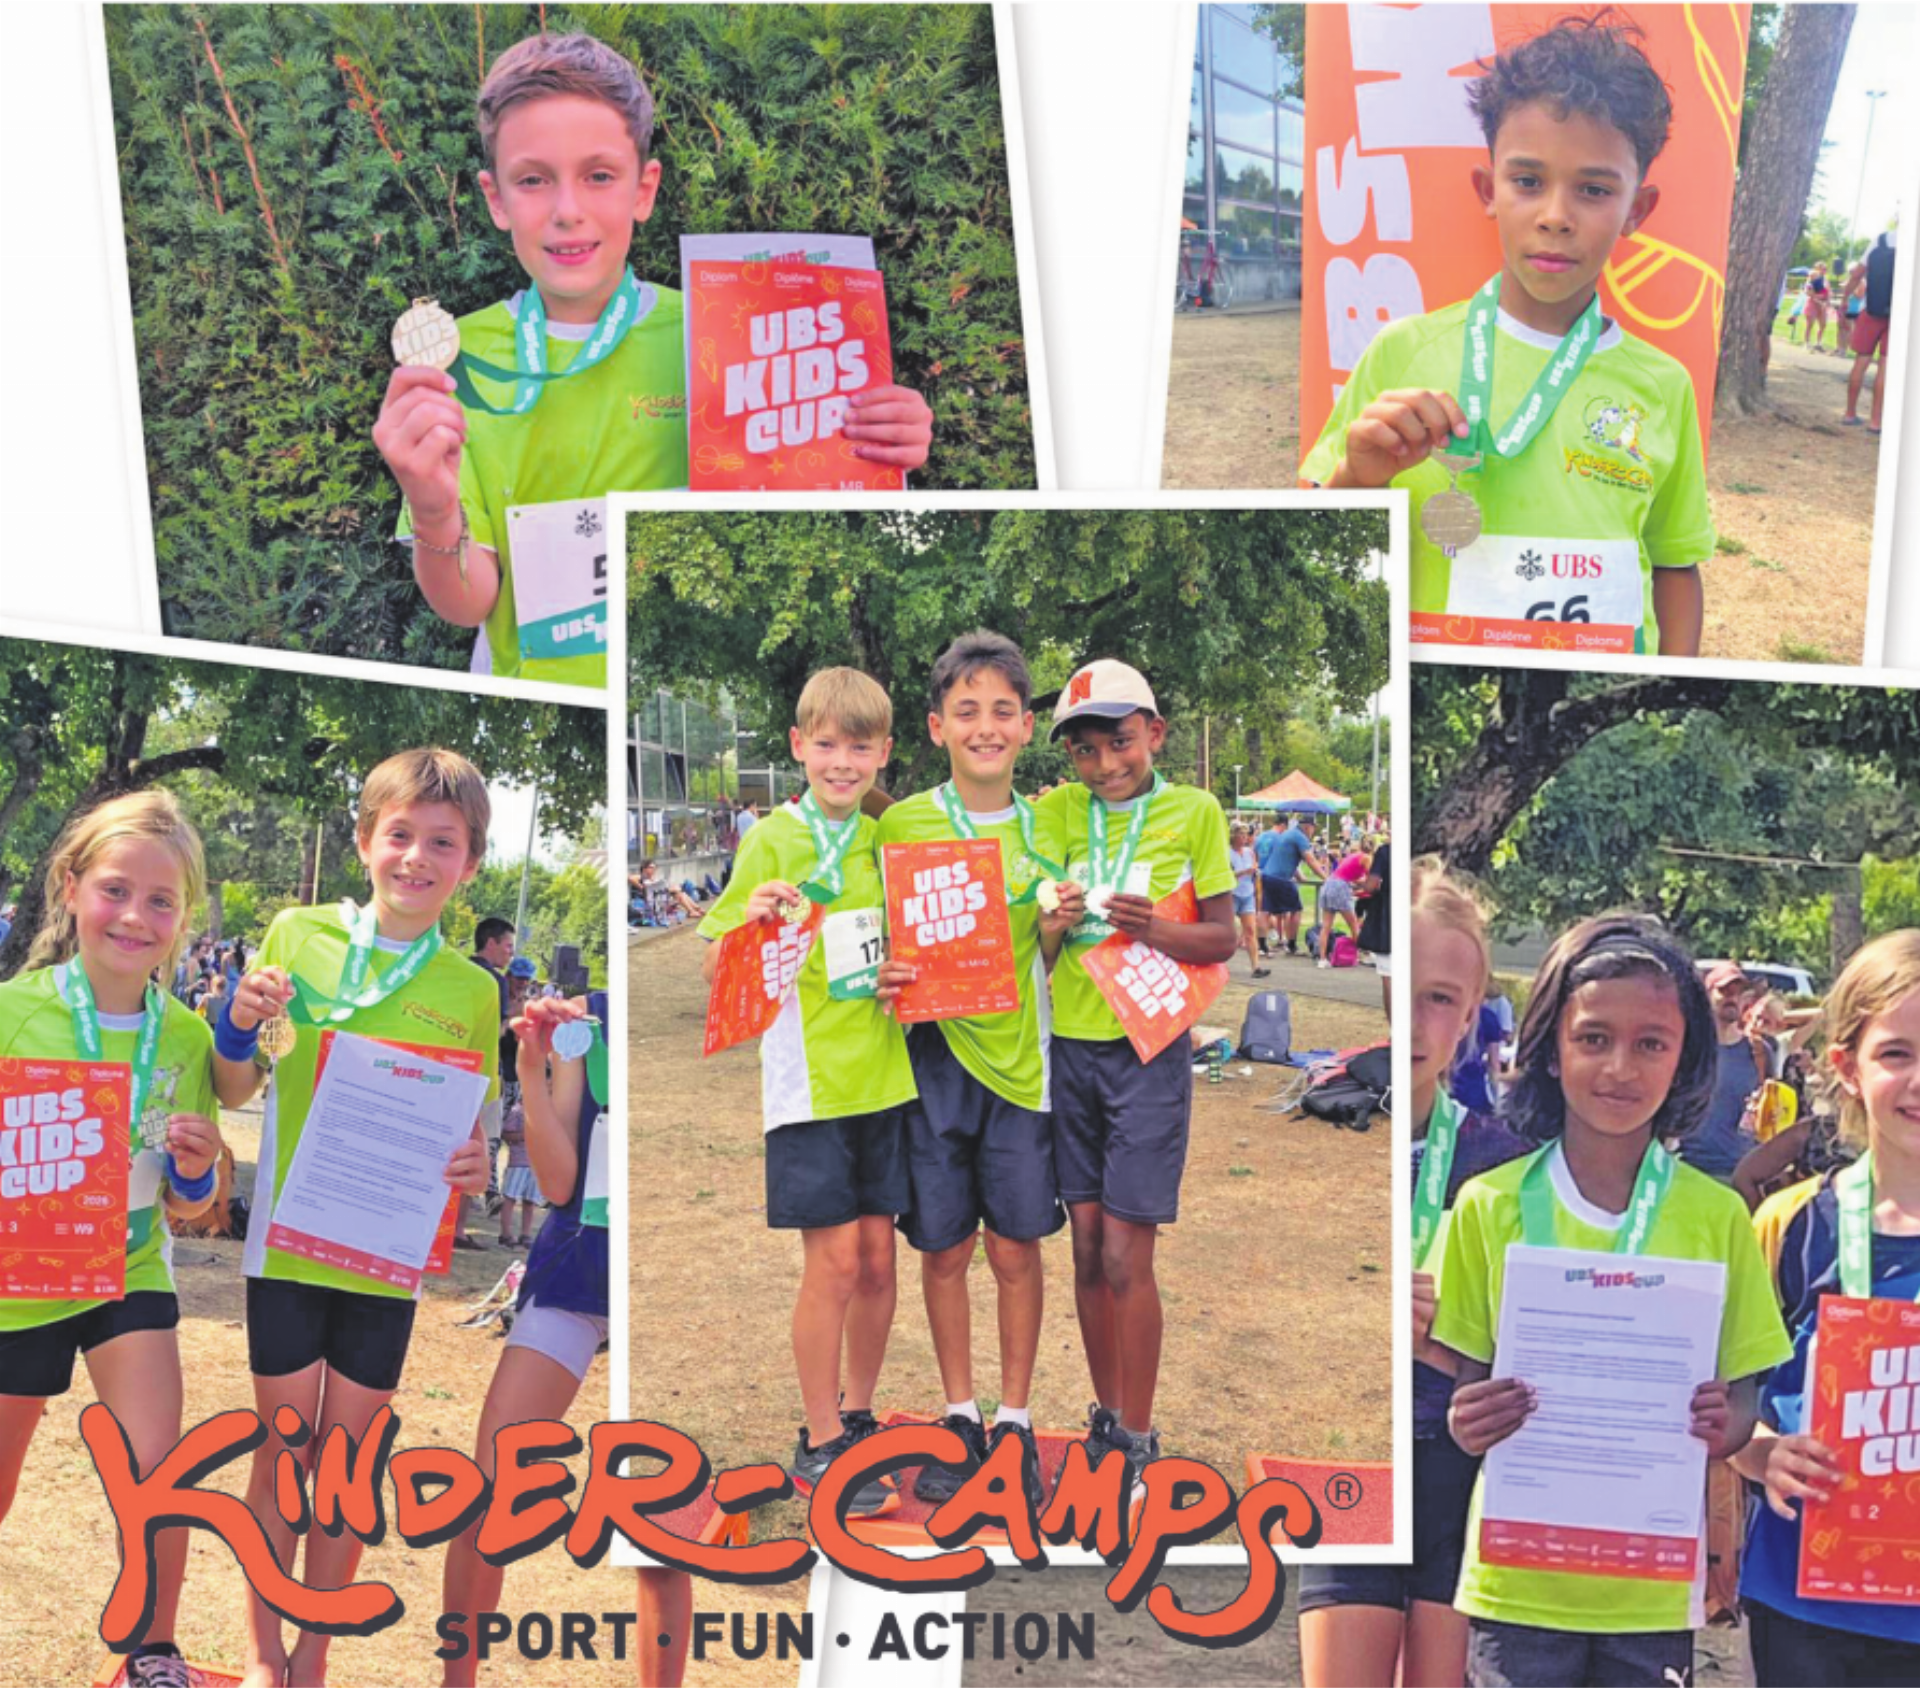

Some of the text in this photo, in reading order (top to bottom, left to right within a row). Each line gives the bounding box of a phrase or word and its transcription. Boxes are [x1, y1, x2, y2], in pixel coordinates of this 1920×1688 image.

[700, 270, 738, 283] Diplom
[773, 272, 814, 286] Diplôme
[391, 312, 460, 363] KIDS
[749, 301, 845, 357] UBS
[724, 339, 869, 418] KIDS
[745, 394, 850, 455] CUP
[1551, 553, 1604, 579] UBS
[1483, 628, 1533, 646] Diplôme
[1575, 633, 1625, 648] Diploma
[1068, 670, 1093, 707] N
[913, 860, 970, 895] UBS
[902, 881, 988, 928] KIDS
[916, 913, 977, 947] CUP
[761, 940, 780, 1000] CUP
[1122, 940, 1187, 1018] KIDS
[1113, 966, 1163, 1020] UBS
[3, 1087, 85, 1128] UBS
[0, 1159, 86, 1199] CUP
[9, 1221, 18, 1234] 3
[73, 1222, 95, 1235] W9
[1826, 1305, 1864, 1318] Diplom
[1868, 1505, 1879, 1519] 2
